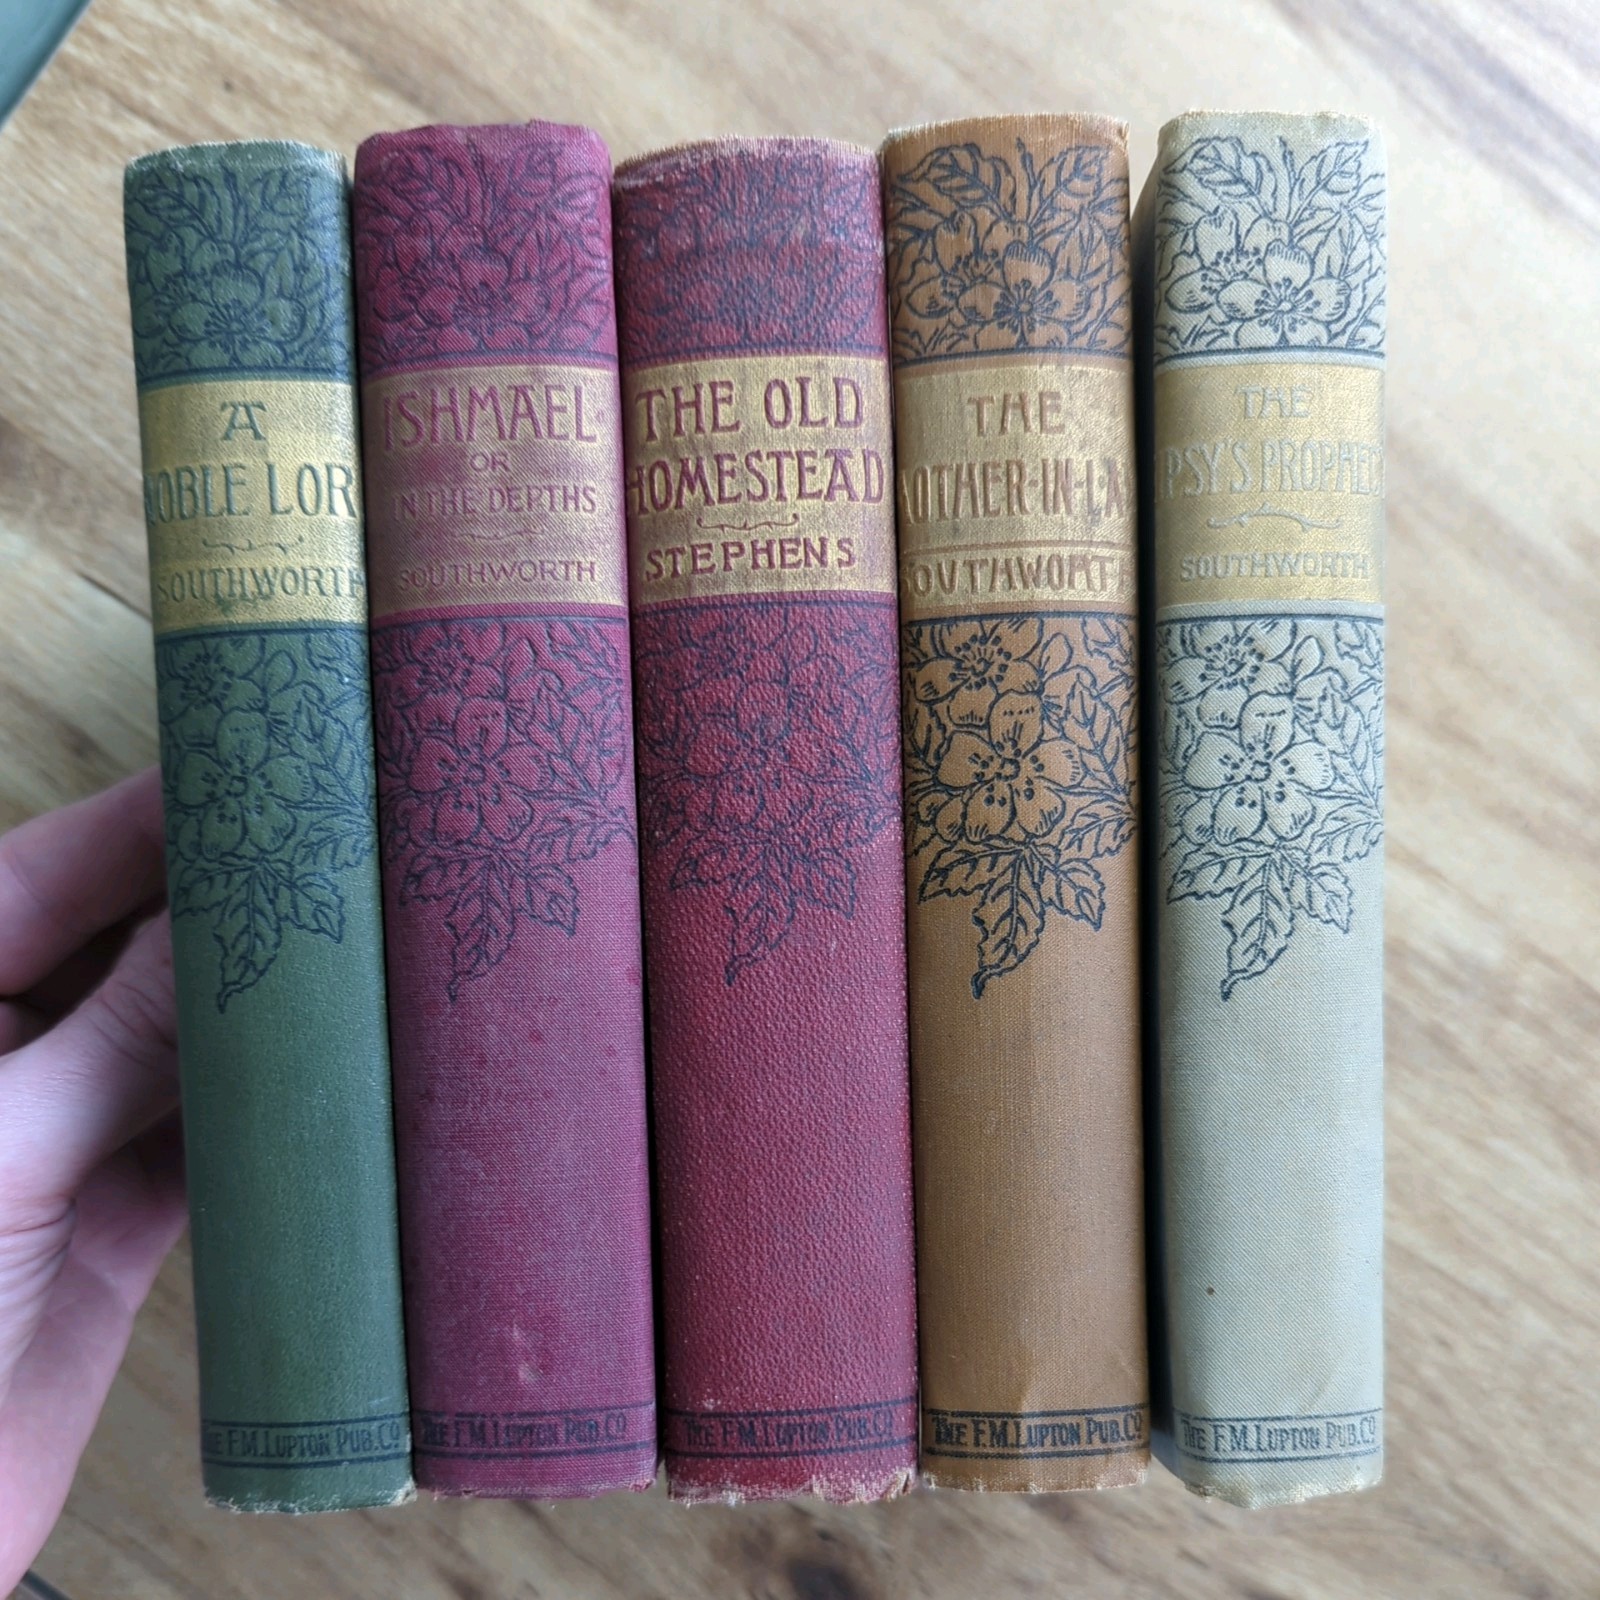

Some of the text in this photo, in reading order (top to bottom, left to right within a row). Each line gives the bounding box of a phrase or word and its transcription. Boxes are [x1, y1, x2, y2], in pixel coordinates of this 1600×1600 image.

[220, 400, 268, 441] A
[636, 376, 864, 442] THE OLD
[967, 391, 1065, 437] THE
[1236, 383, 1315, 421] THE
[469, 452, 511, 473] OR
[627, 449, 885, 516] HOMESTEAD
[901, 458, 1130, 525] OTHER-IN-LA
[392, 484, 597, 521] IN THE DEPTHS
[401, 560, 596, 591] SOUTHWORTH
[646, 537, 856, 581] STEPHENS
[1180, 553, 1372, 582] SOUTHWORTH
[684, 1418, 715, 1447] THE
[932, 1415, 967, 1447] THE
[1180, 1418, 1207, 1450] THE
